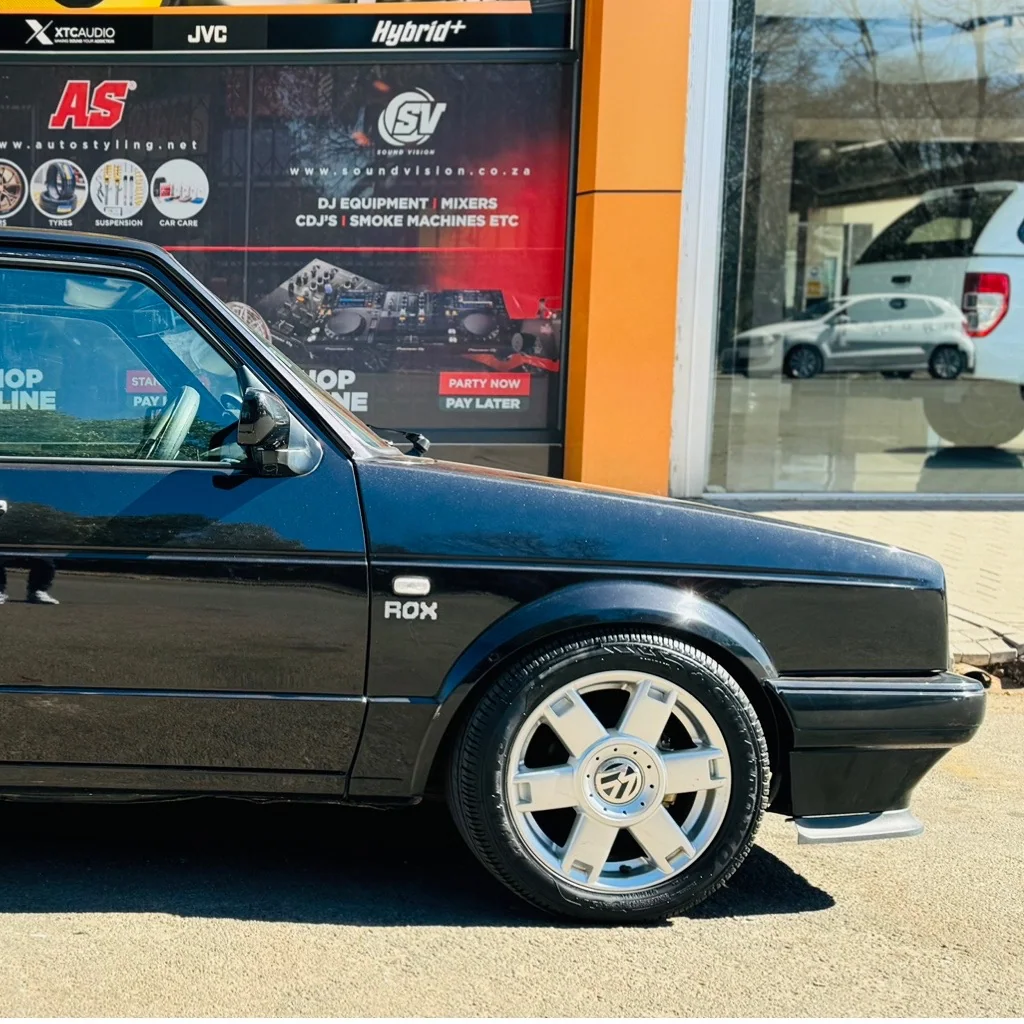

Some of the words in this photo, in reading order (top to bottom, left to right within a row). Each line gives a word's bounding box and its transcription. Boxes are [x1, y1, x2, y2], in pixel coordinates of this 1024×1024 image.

[54, 26, 116, 38] XTCAUDIO
[187, 25, 227, 43] JVC
[372, 20, 466, 46] Hybrid+
[391, 102, 447, 136] SV
[289, 166, 531, 176] www.soundvision.co.za
[318, 198, 337, 210] DJ
[340, 198, 429, 210] EQUIPMENT
[441, 198, 498, 210] MIXERS
[48, 219, 73, 227] TYRES
[95, 219, 143, 227] SUSPENSION
[159, 219, 175, 227] CAR
[177, 219, 198, 227] CARE
[295, 215, 338, 227] CDJ'S
[349, 215, 403, 227] SMOKE
[406, 215, 486, 227] MACHINES
[489, 215, 519, 227] ETC
[309, 369, 356, 390] OP
[449, 378, 487, 389] PARTY
[490, 379, 521, 389] NOW
[133, 396, 160, 407] PAY
[446, 398, 472, 409] PAY
[475, 398, 521, 410] LATER
[384, 600, 438, 620] ROX
